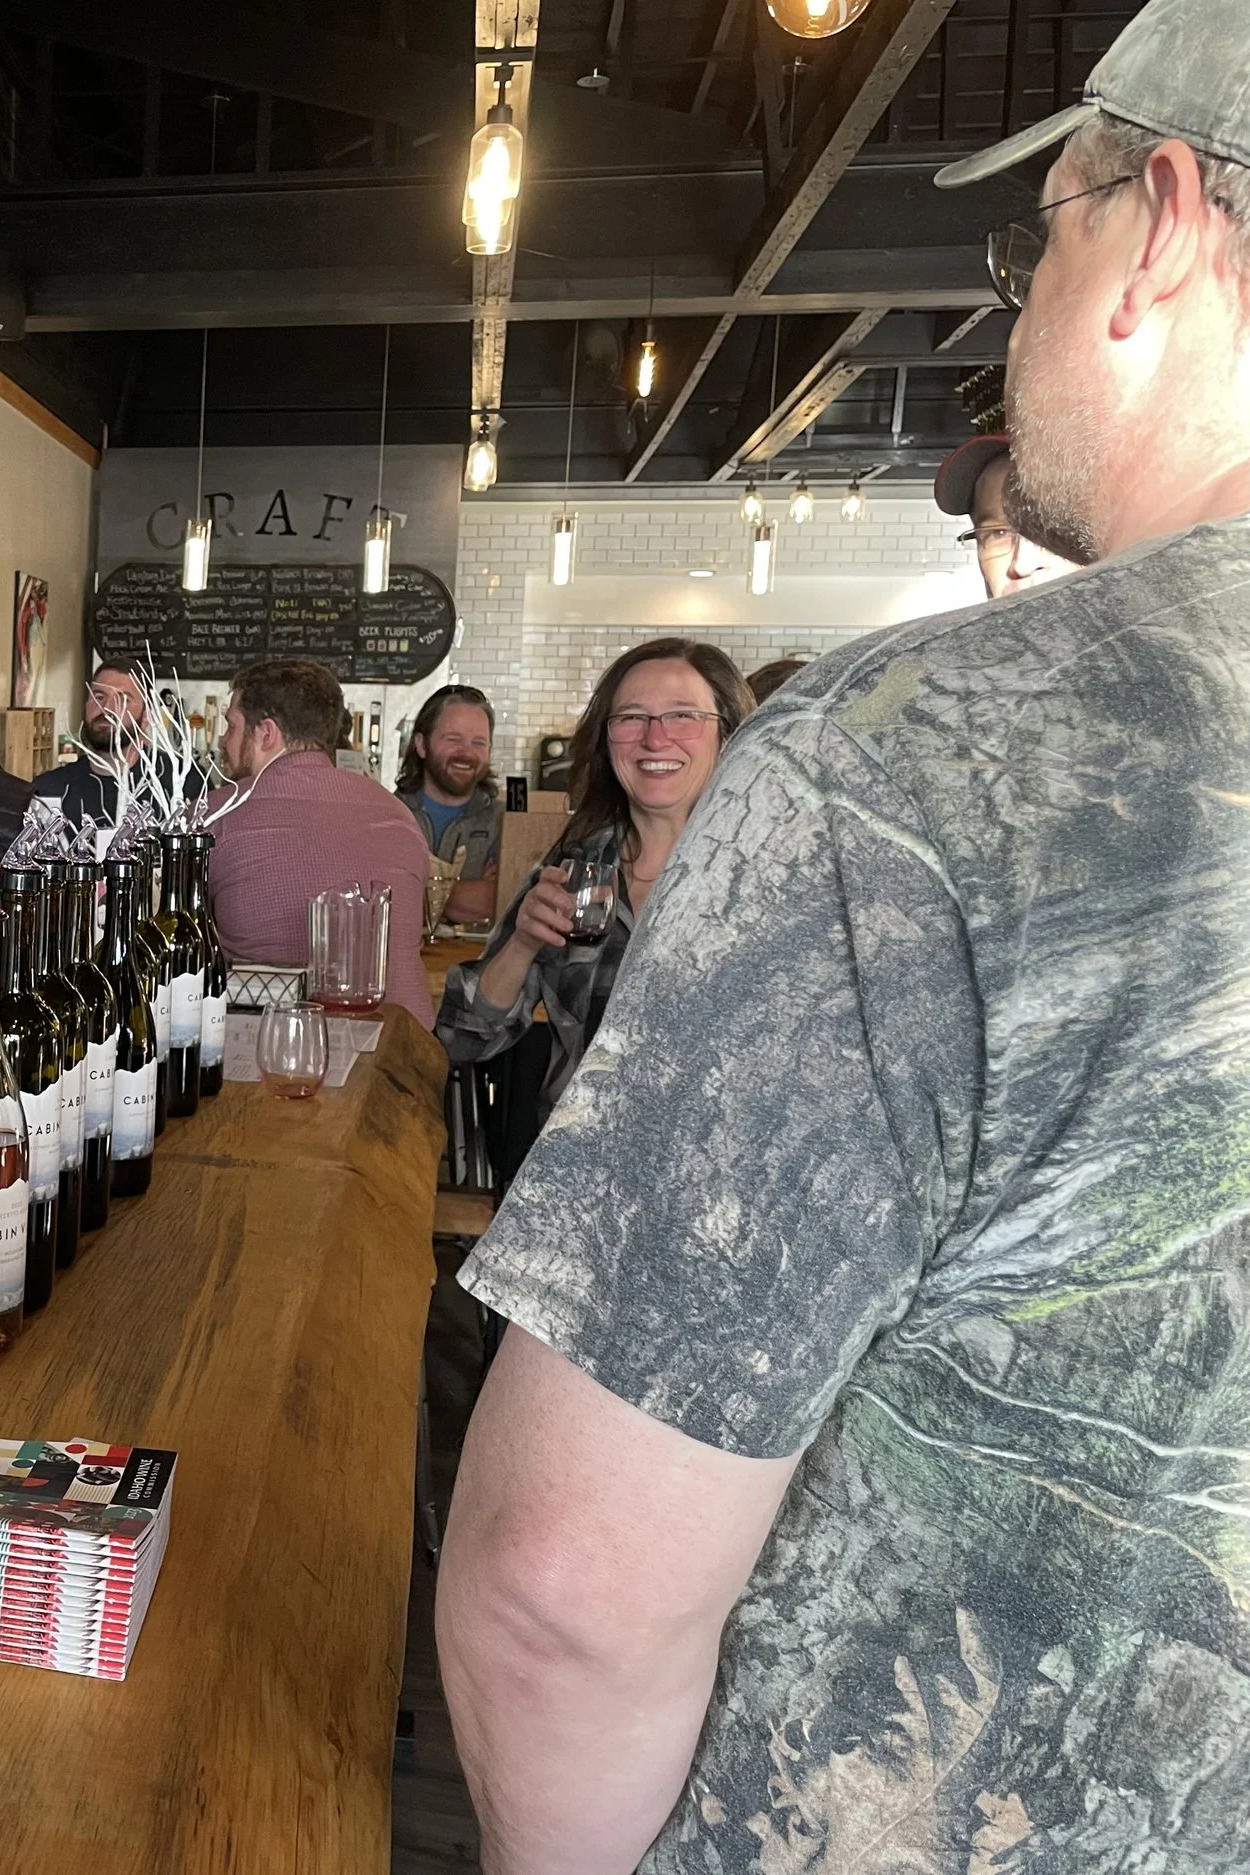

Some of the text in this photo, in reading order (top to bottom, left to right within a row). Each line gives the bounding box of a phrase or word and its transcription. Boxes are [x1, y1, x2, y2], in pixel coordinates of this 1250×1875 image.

[90, 1069, 111, 1080] CAB
[127, 1458, 153, 1500] IDAHO WINE
[143, 1462, 161, 1499] COMMISSION
